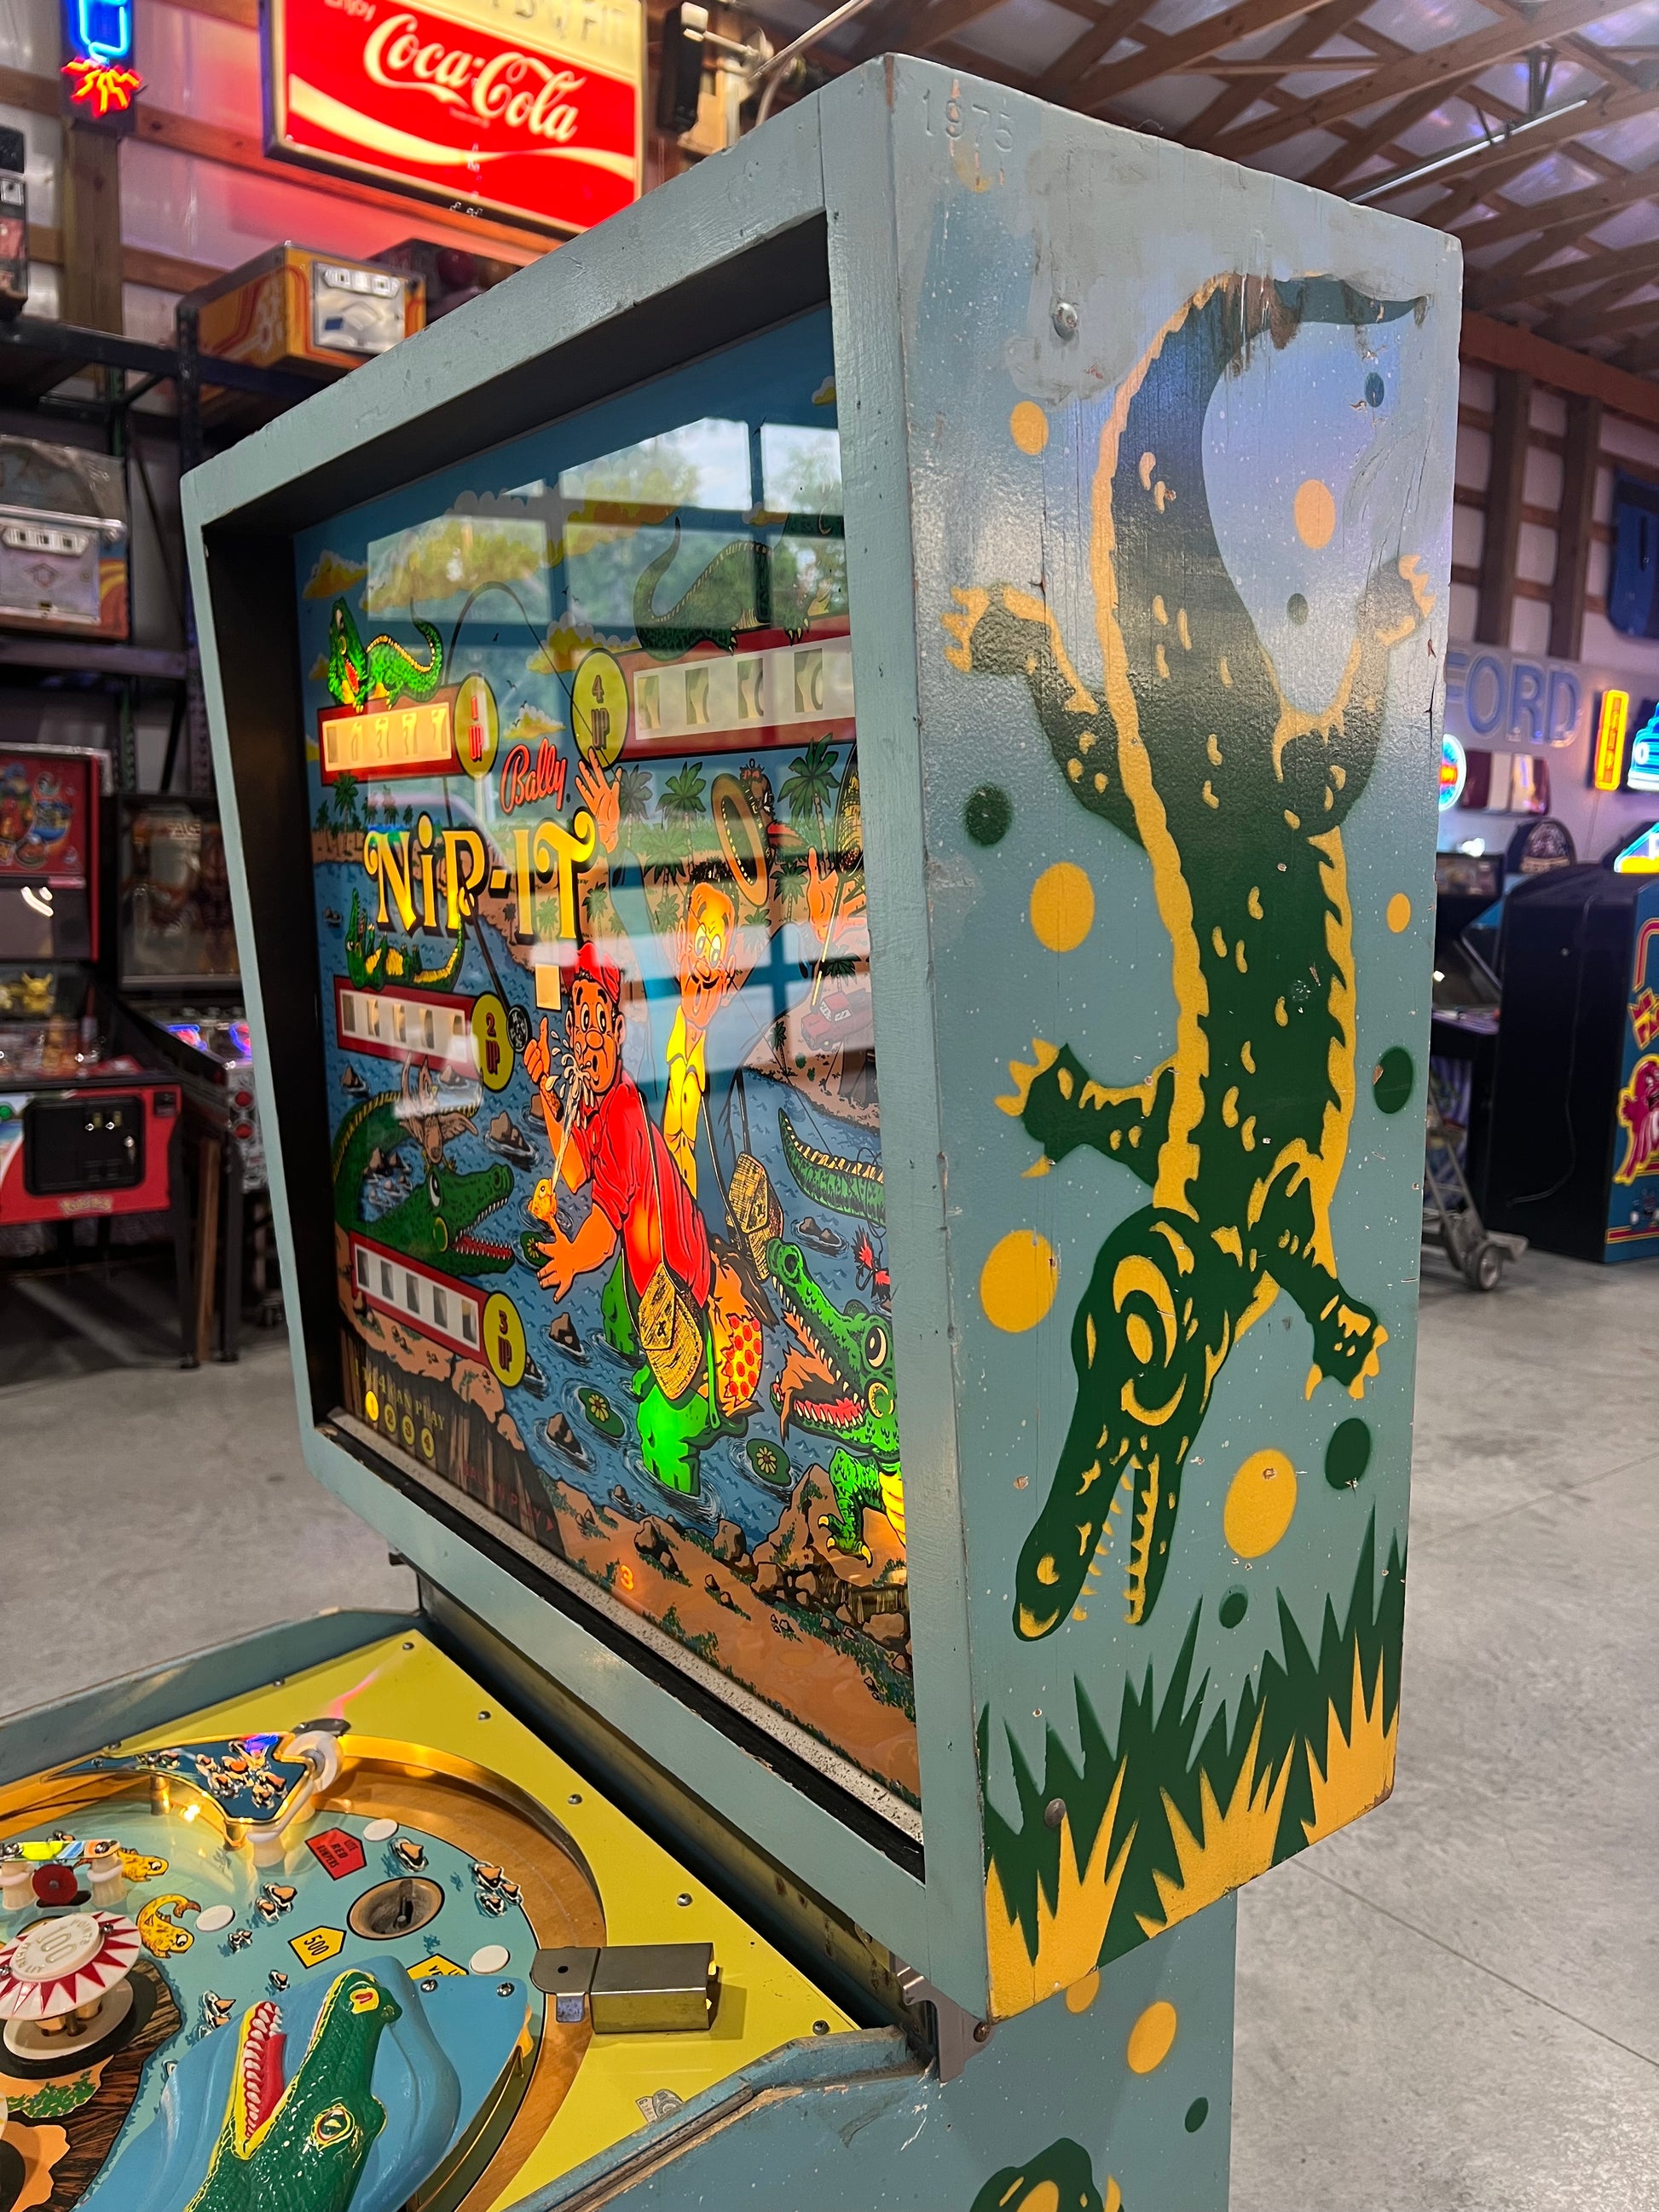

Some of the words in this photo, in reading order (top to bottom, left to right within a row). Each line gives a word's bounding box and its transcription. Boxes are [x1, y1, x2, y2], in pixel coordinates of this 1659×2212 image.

[363, 14, 587, 143] Coca-Cola
[922, 89, 1014, 152] 1975
[591, 674, 605, 704] 4
[471, 695, 478, 721] 1
[469, 724, 483, 762] UP
[590, 707, 610, 750] UP
[500, 737, 570, 814] Bally
[485, 1012, 497, 1037] 2
[485, 1038, 500, 1075] UP
[498, 1308, 509, 1336] 3
[497, 1335, 513, 1372] UP
[415, 1400, 445, 1431] PLAY
[620, 1565, 635, 1591] 3
[330, 1842, 350, 1859] RED
[35, 1925, 78, 1964] 100
[303, 1934, 330, 1956] 500
